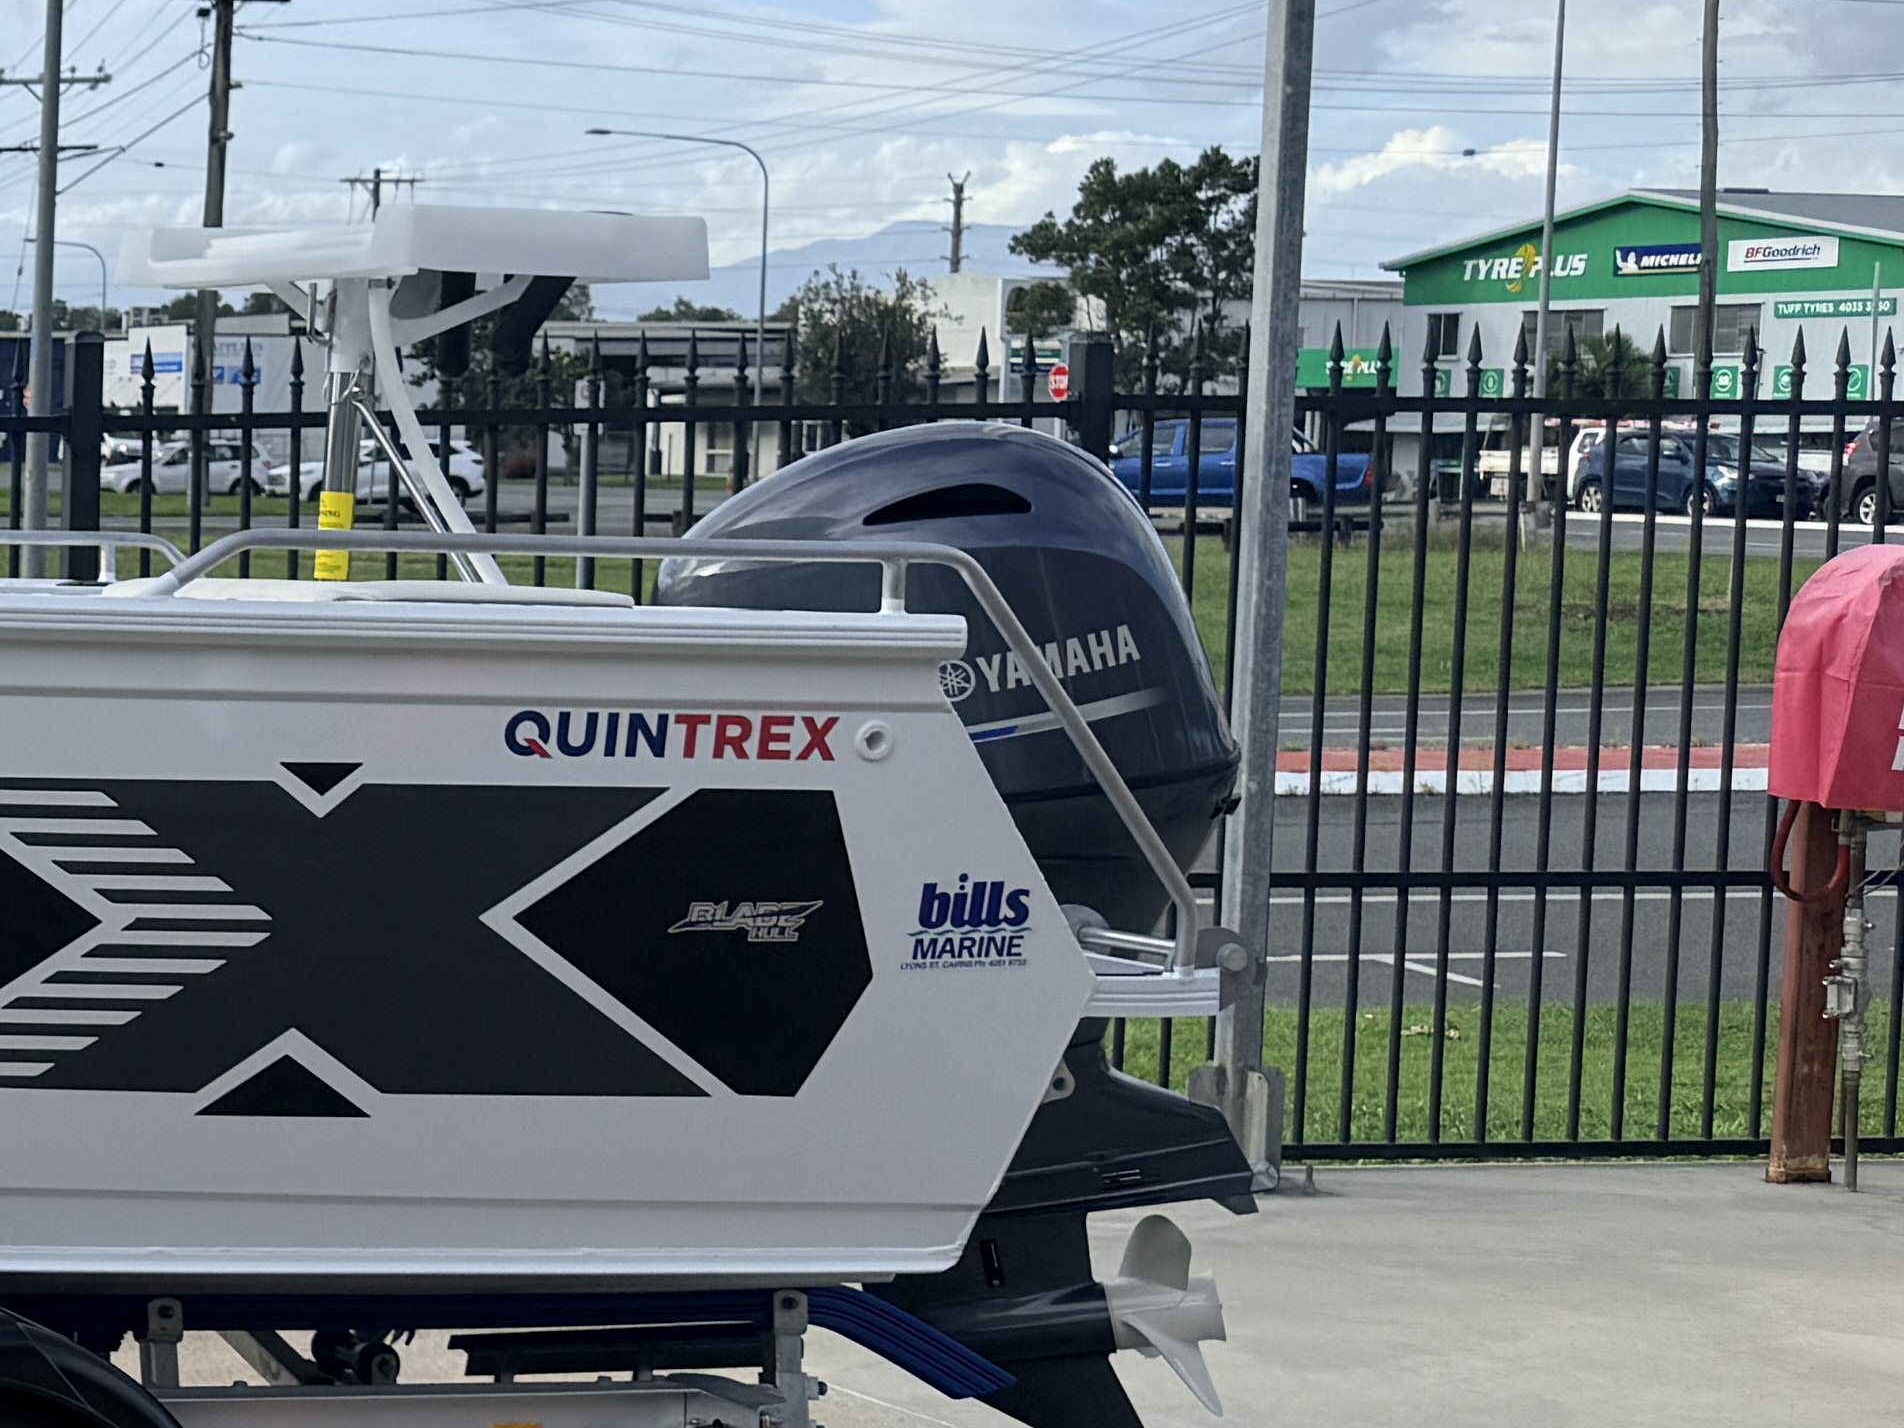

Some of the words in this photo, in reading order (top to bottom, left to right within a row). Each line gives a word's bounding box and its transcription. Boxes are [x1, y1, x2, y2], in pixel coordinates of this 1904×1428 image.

[1640, 253, 1703, 268] MICHELI
[1744, 244, 1821, 259] BFGoodrich
[1777, 303, 1803, 315] TUFF
[1803, 302, 1834, 314] TYRES
[975, 624, 1142, 693] YAMAHA
[503, 709, 841, 762] QUINTREX
[918, 873, 1030, 930] bills
[684, 901, 810, 930] BLADE
[749, 926, 798, 941] HULL
[912, 935, 1025, 960] MARINE
